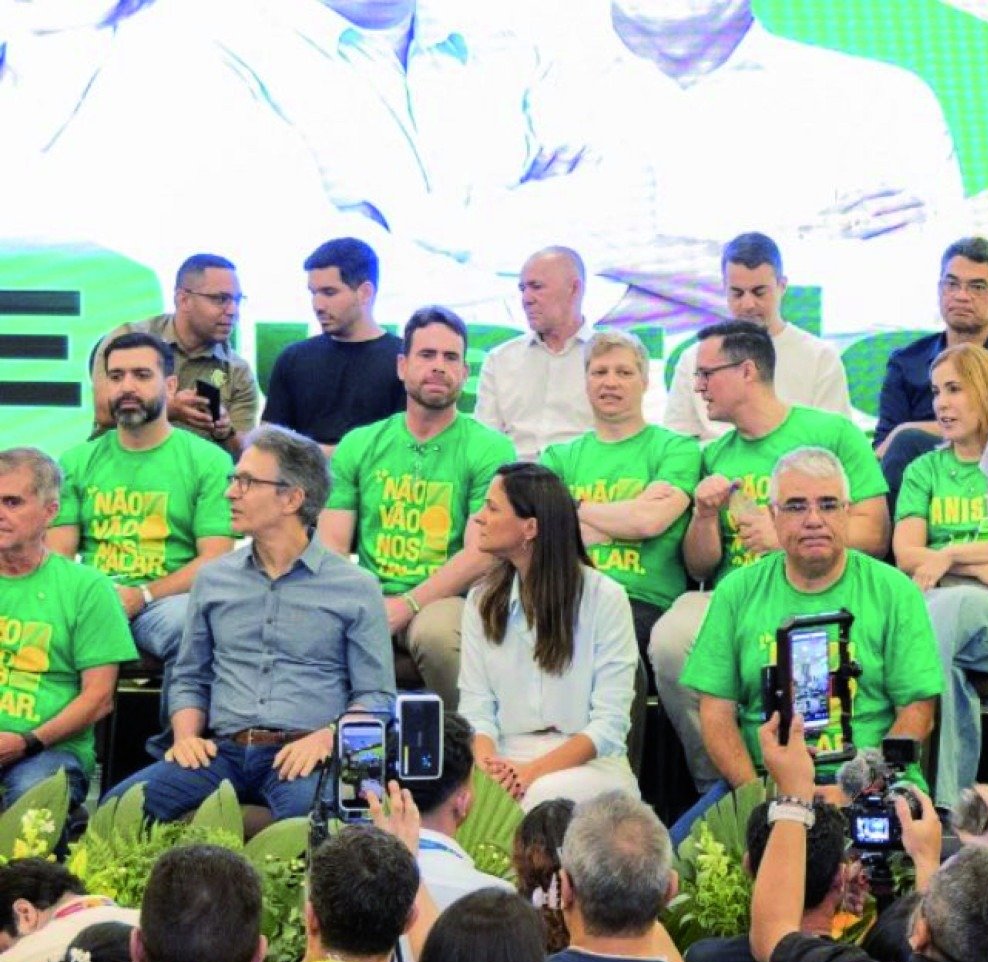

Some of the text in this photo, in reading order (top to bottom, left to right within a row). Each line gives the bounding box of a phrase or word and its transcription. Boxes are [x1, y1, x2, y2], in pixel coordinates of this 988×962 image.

[94, 487, 142, 517] NÃO
[382, 473, 426, 504] NÃO
[379, 501, 421, 534] VÃO
[376, 532, 421, 562] NOS
